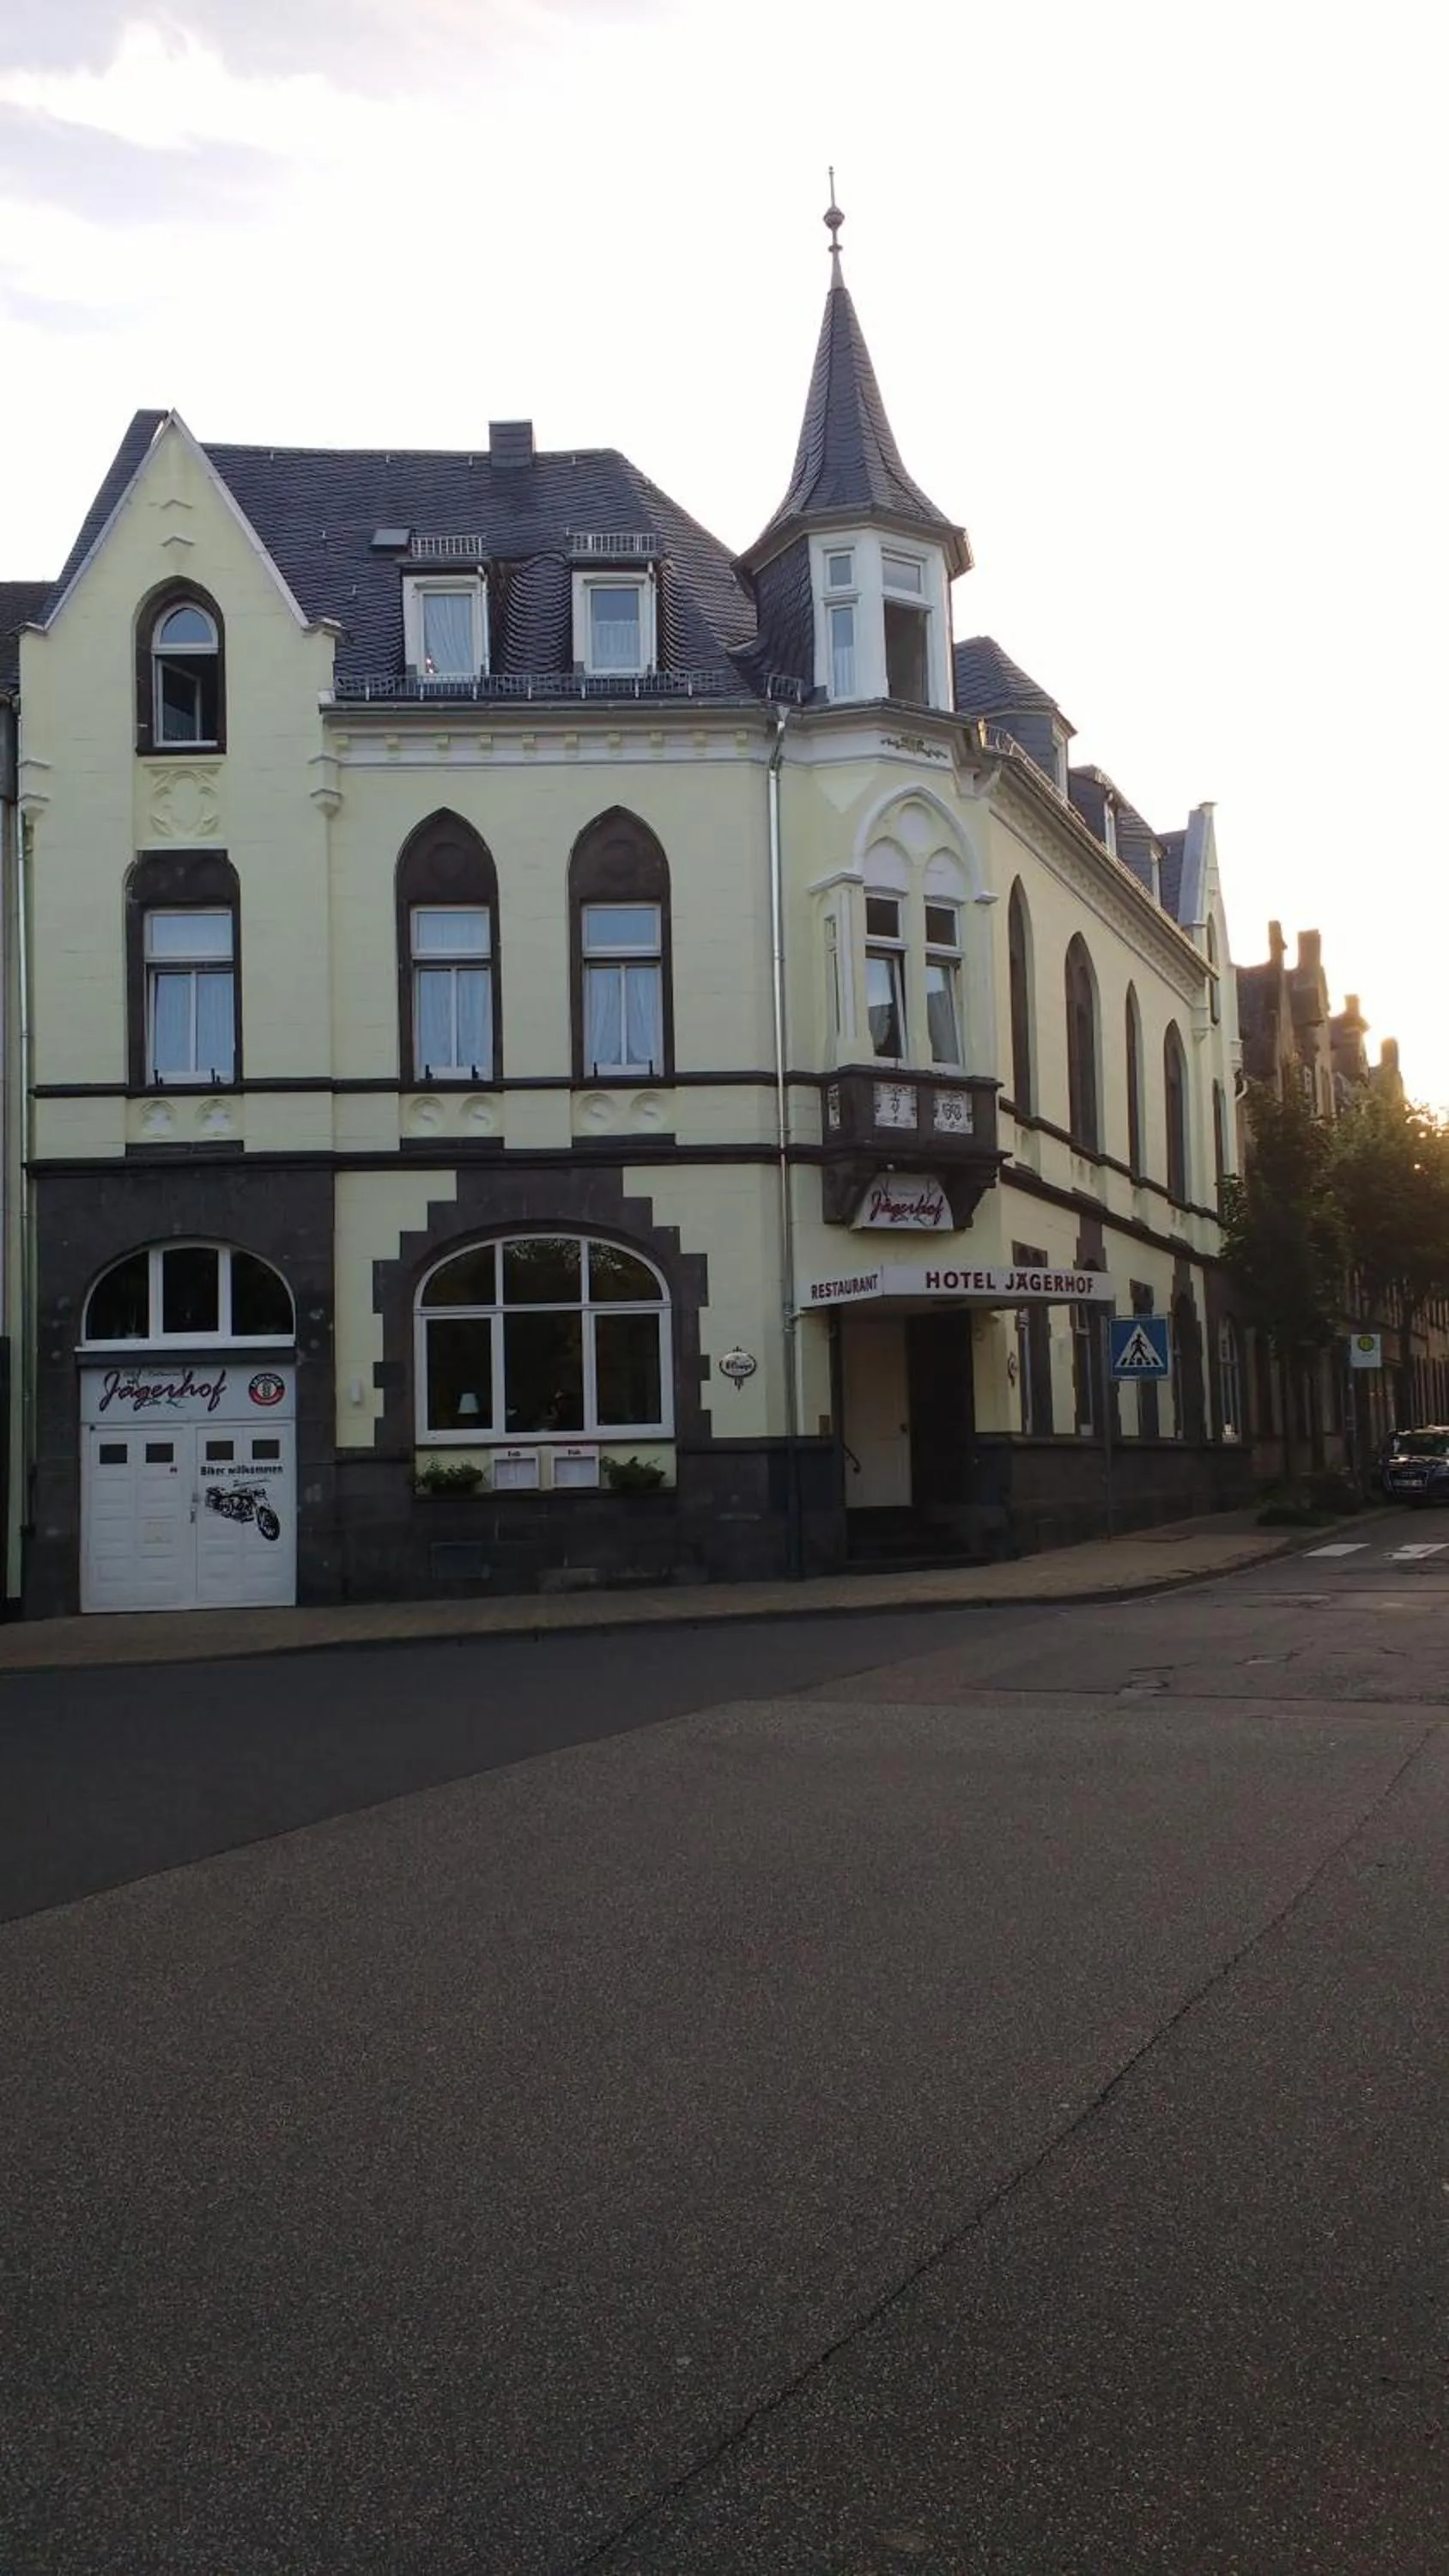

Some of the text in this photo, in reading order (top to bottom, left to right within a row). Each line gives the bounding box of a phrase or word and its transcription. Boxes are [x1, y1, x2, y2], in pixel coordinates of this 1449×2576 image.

[810, 1273, 878, 1299] RESTAURANT
[926, 1271, 1094, 1293] HOTEL JÄGERHOF
[99, 1369, 227, 1412] Jägerhof
